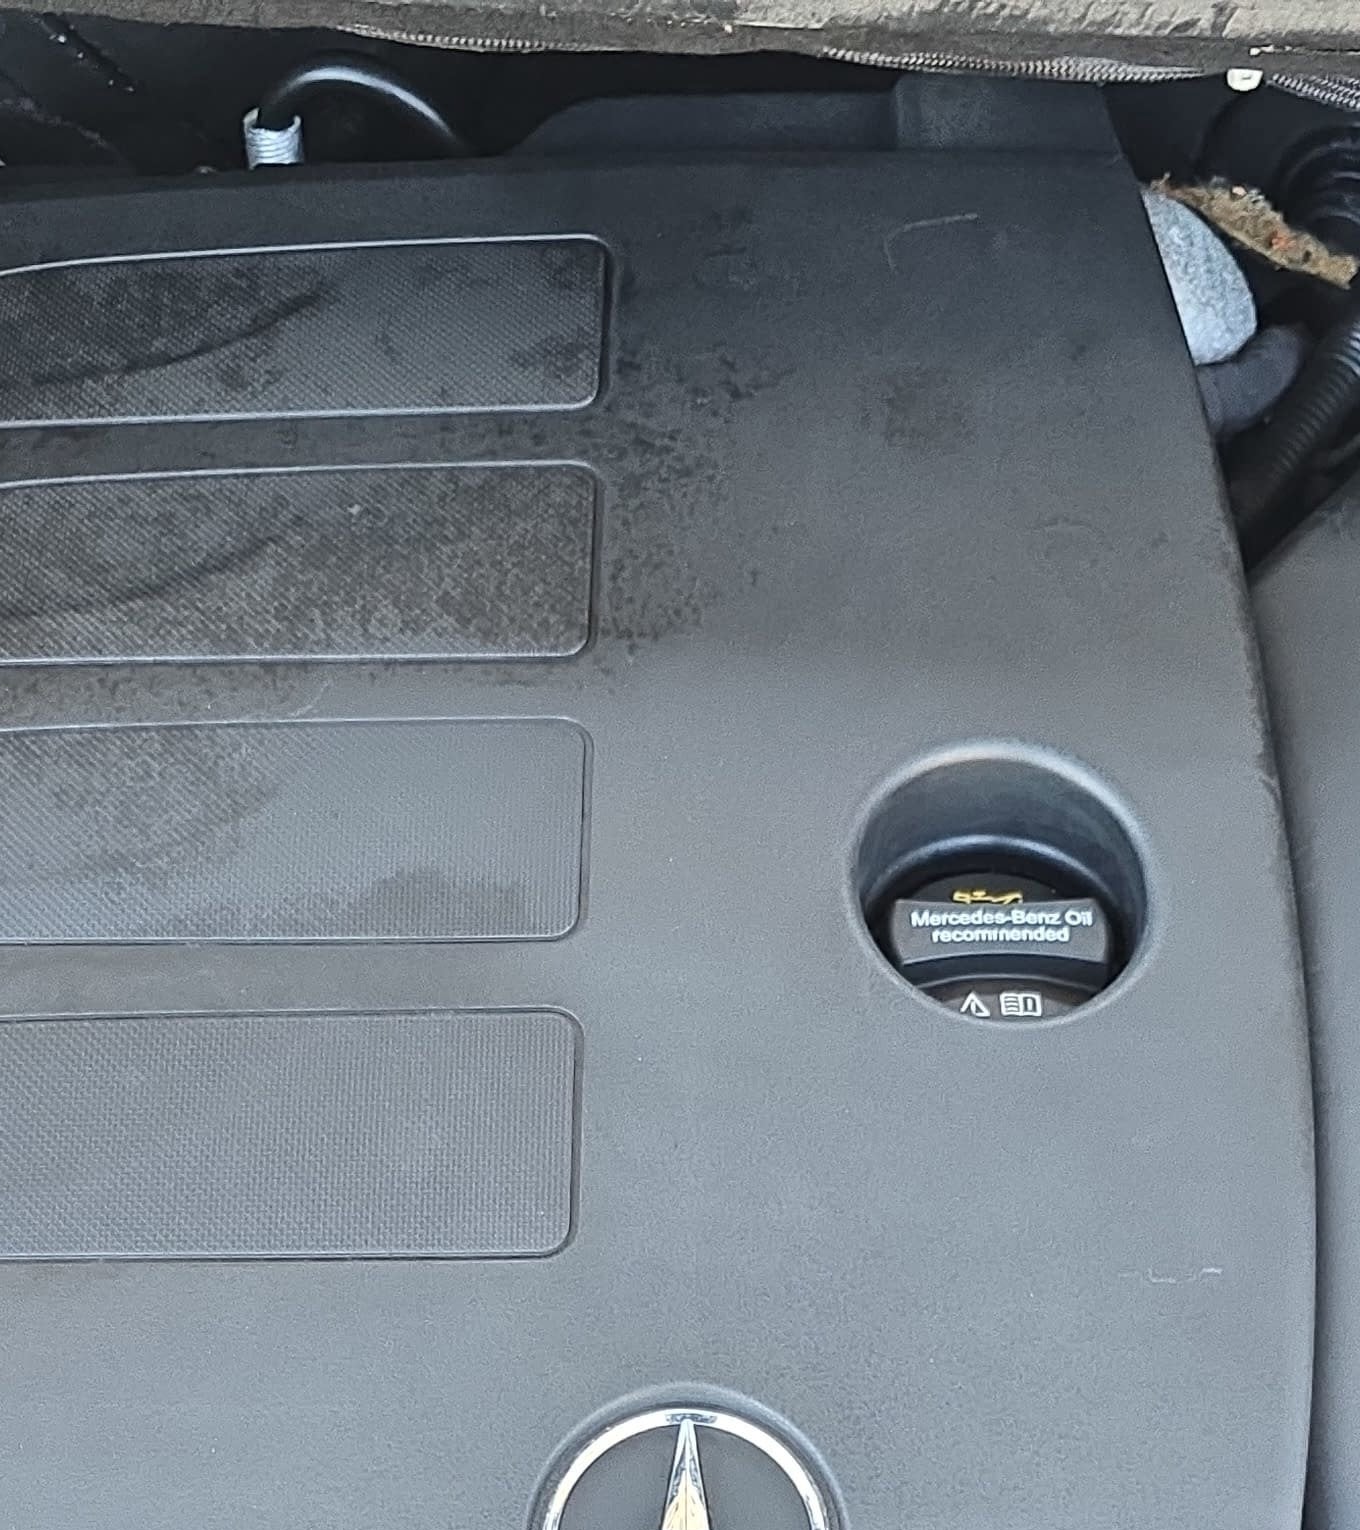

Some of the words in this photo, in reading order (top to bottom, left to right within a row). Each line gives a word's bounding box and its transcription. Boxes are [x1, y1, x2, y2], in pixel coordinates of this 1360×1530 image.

[911, 909, 1061, 928] Mercedes-Benz
[1064, 909, 1093, 927] Oil
[931, 925, 1070, 943] recommended
